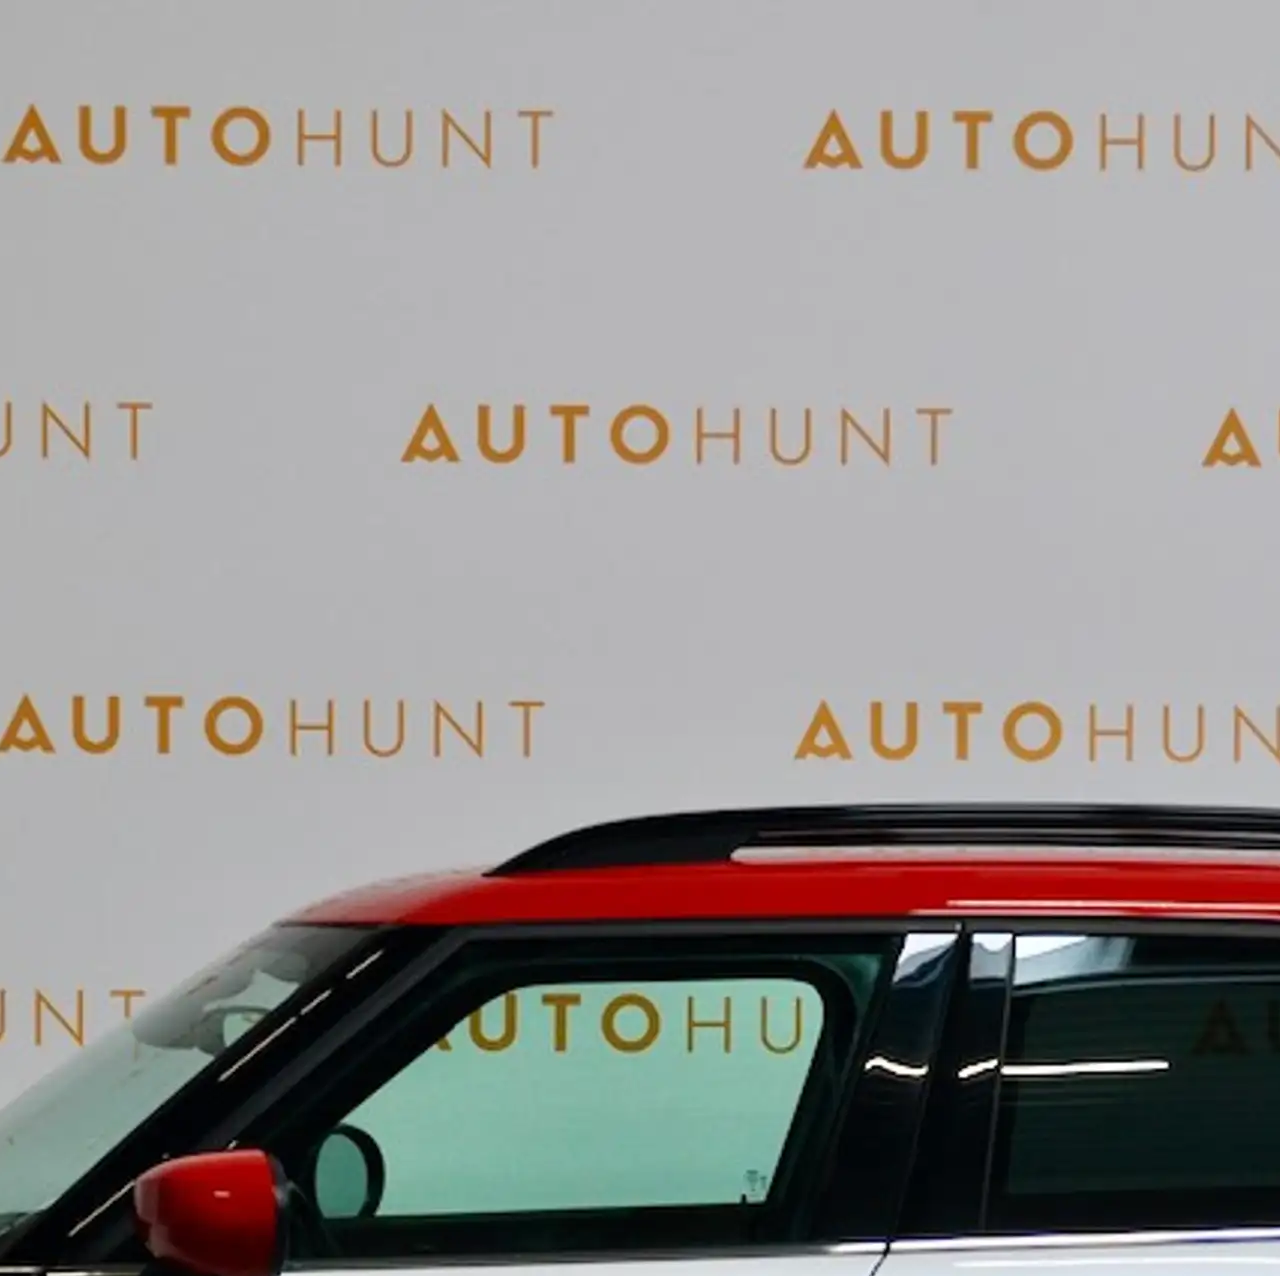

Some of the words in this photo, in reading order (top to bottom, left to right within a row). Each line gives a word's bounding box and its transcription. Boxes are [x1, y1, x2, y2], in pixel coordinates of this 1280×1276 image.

[1, 103, 550, 168] AUTOHUNT
[401, 402, 952, 466] AUTOHUNT
[435, 992, 804, 1054] UTOHU
